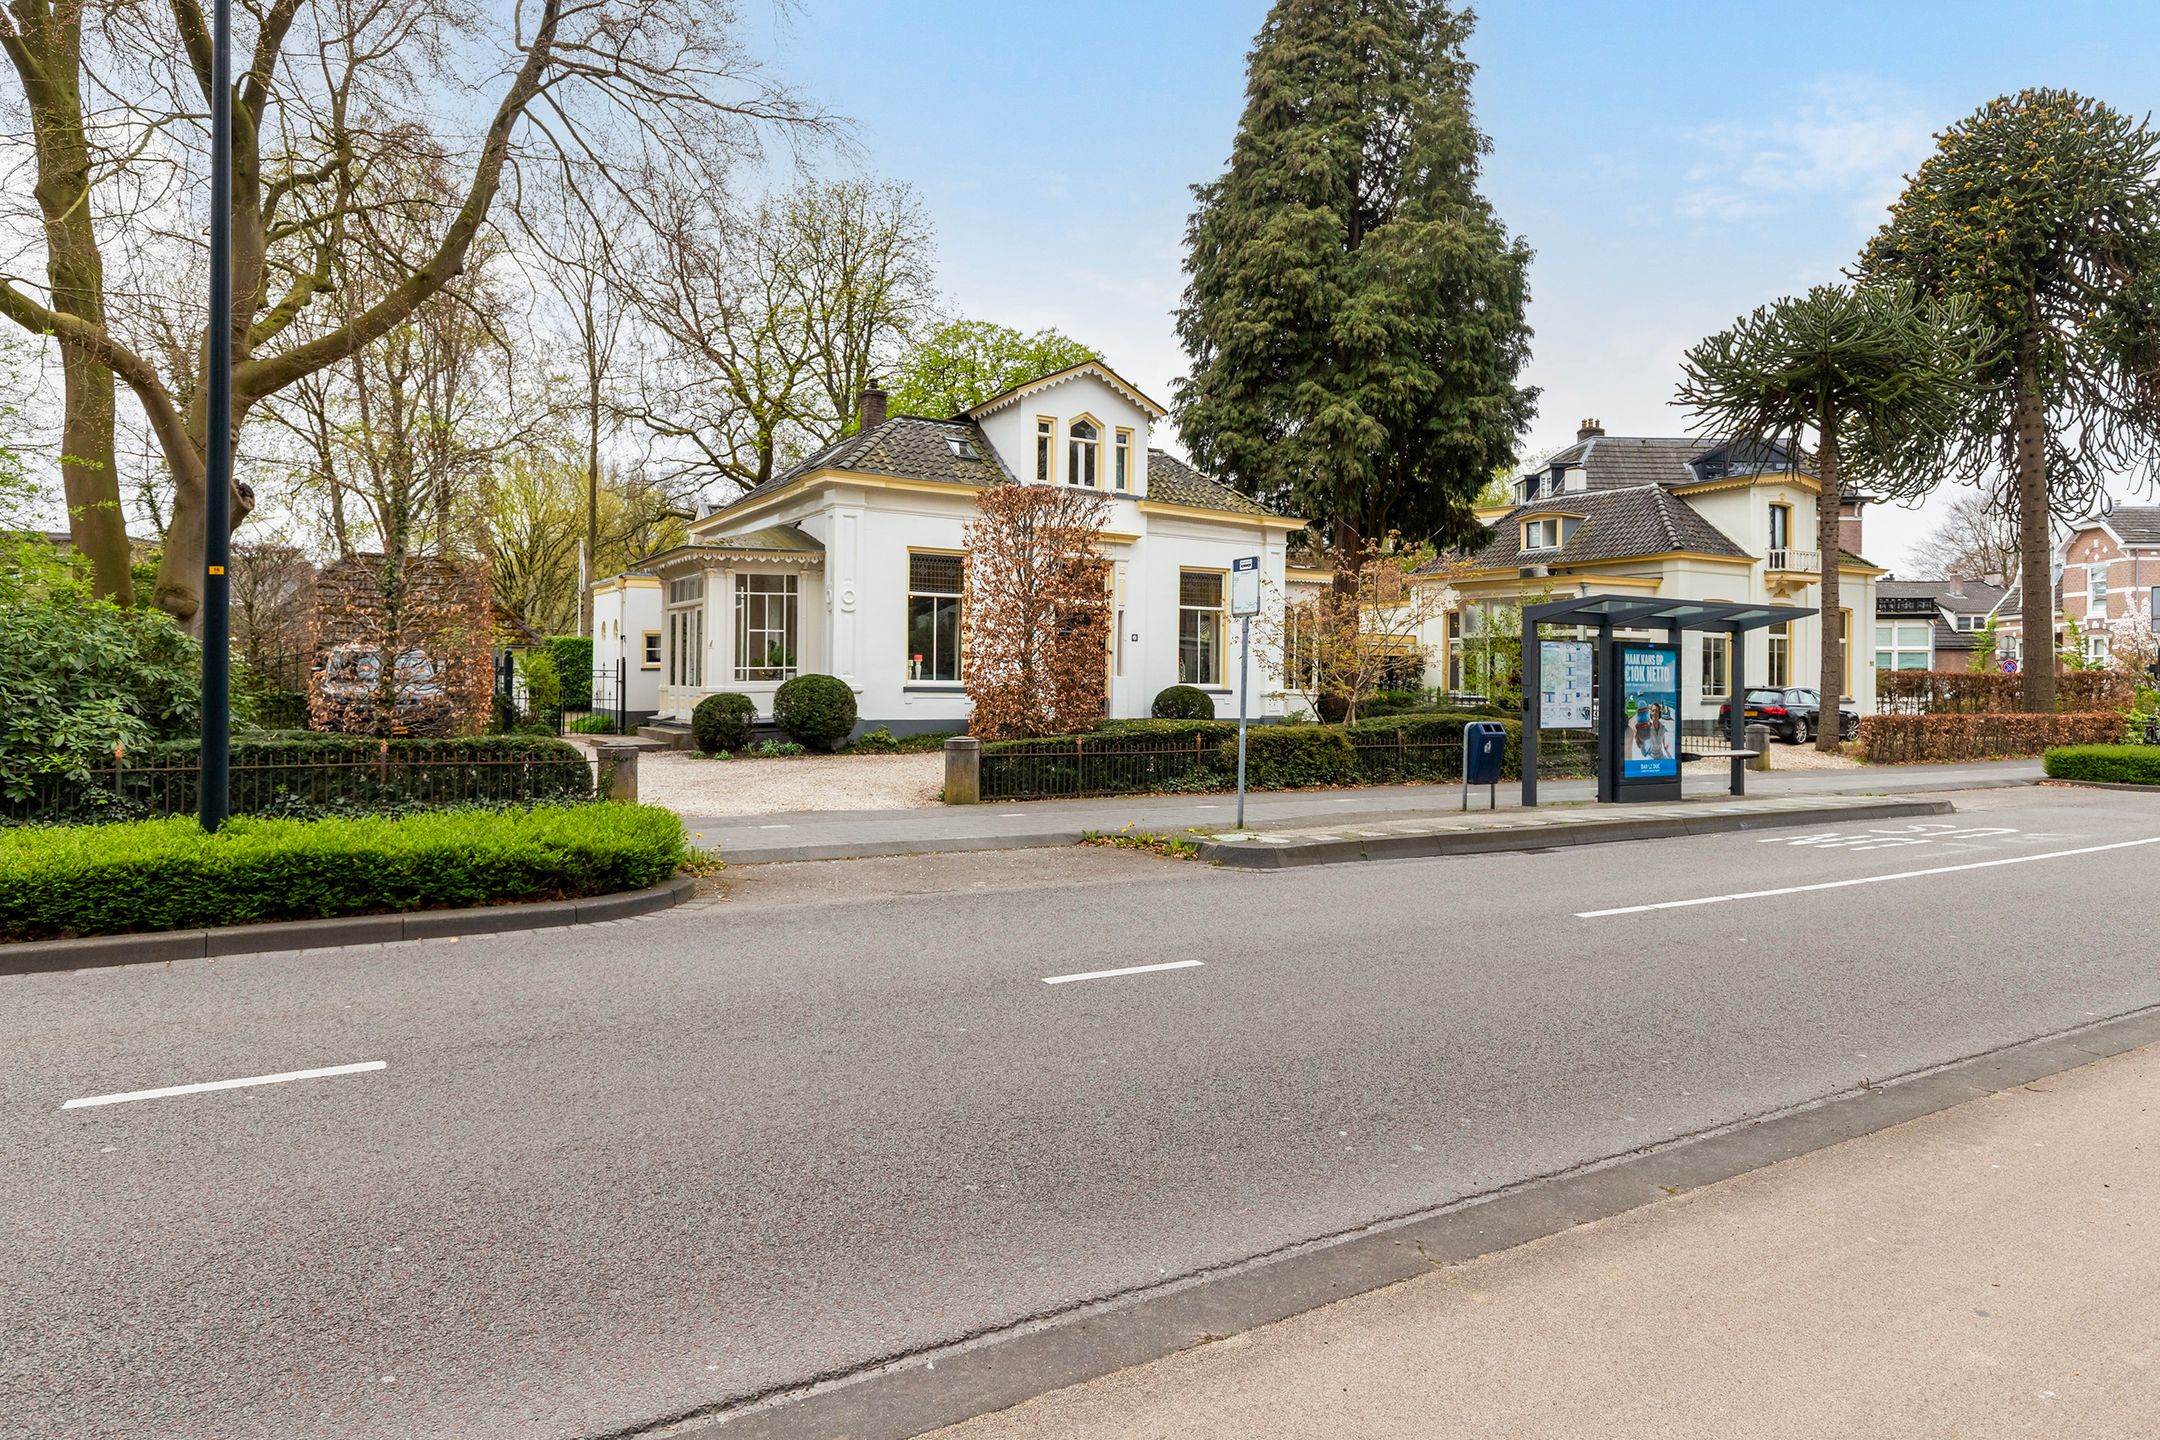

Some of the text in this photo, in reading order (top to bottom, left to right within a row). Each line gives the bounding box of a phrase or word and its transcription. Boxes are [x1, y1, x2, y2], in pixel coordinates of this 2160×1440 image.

[1625, 653, 1664, 666] MAAK KANS OP
[1646, 666, 1670, 682] NETTO
